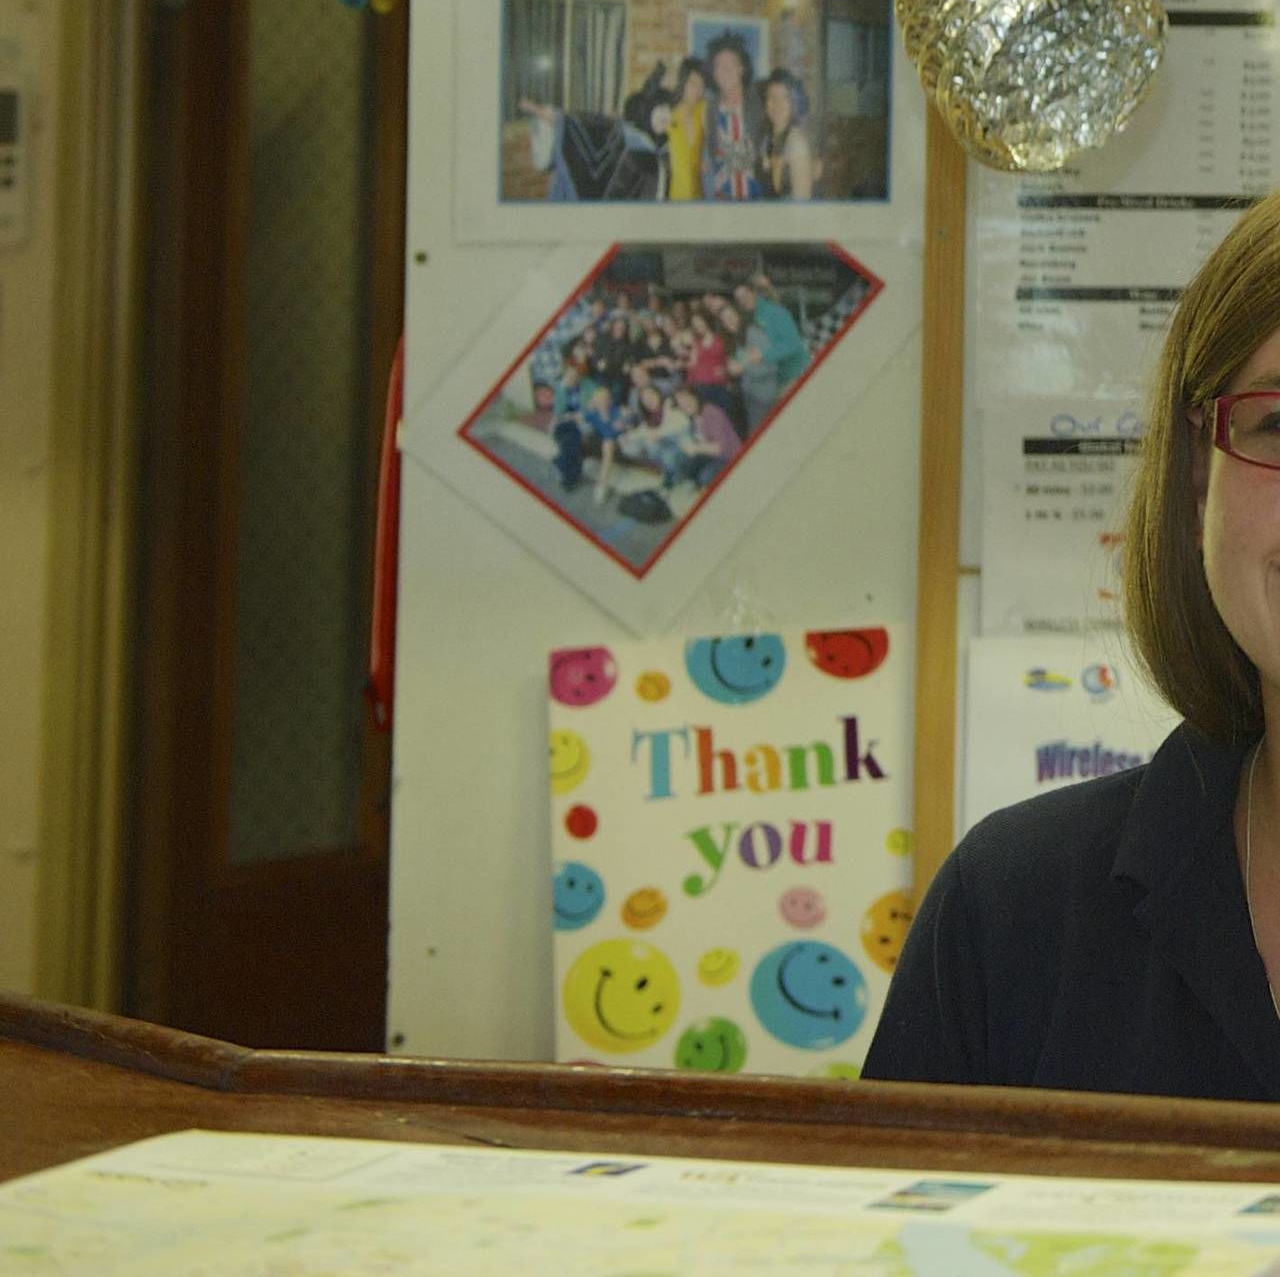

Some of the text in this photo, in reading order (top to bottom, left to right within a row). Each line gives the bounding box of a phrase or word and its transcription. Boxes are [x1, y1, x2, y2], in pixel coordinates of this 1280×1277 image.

[630, 715, 890, 801] Thank
[1035, 738, 1142, 783] Wireless
[682, 818, 834, 897] you
